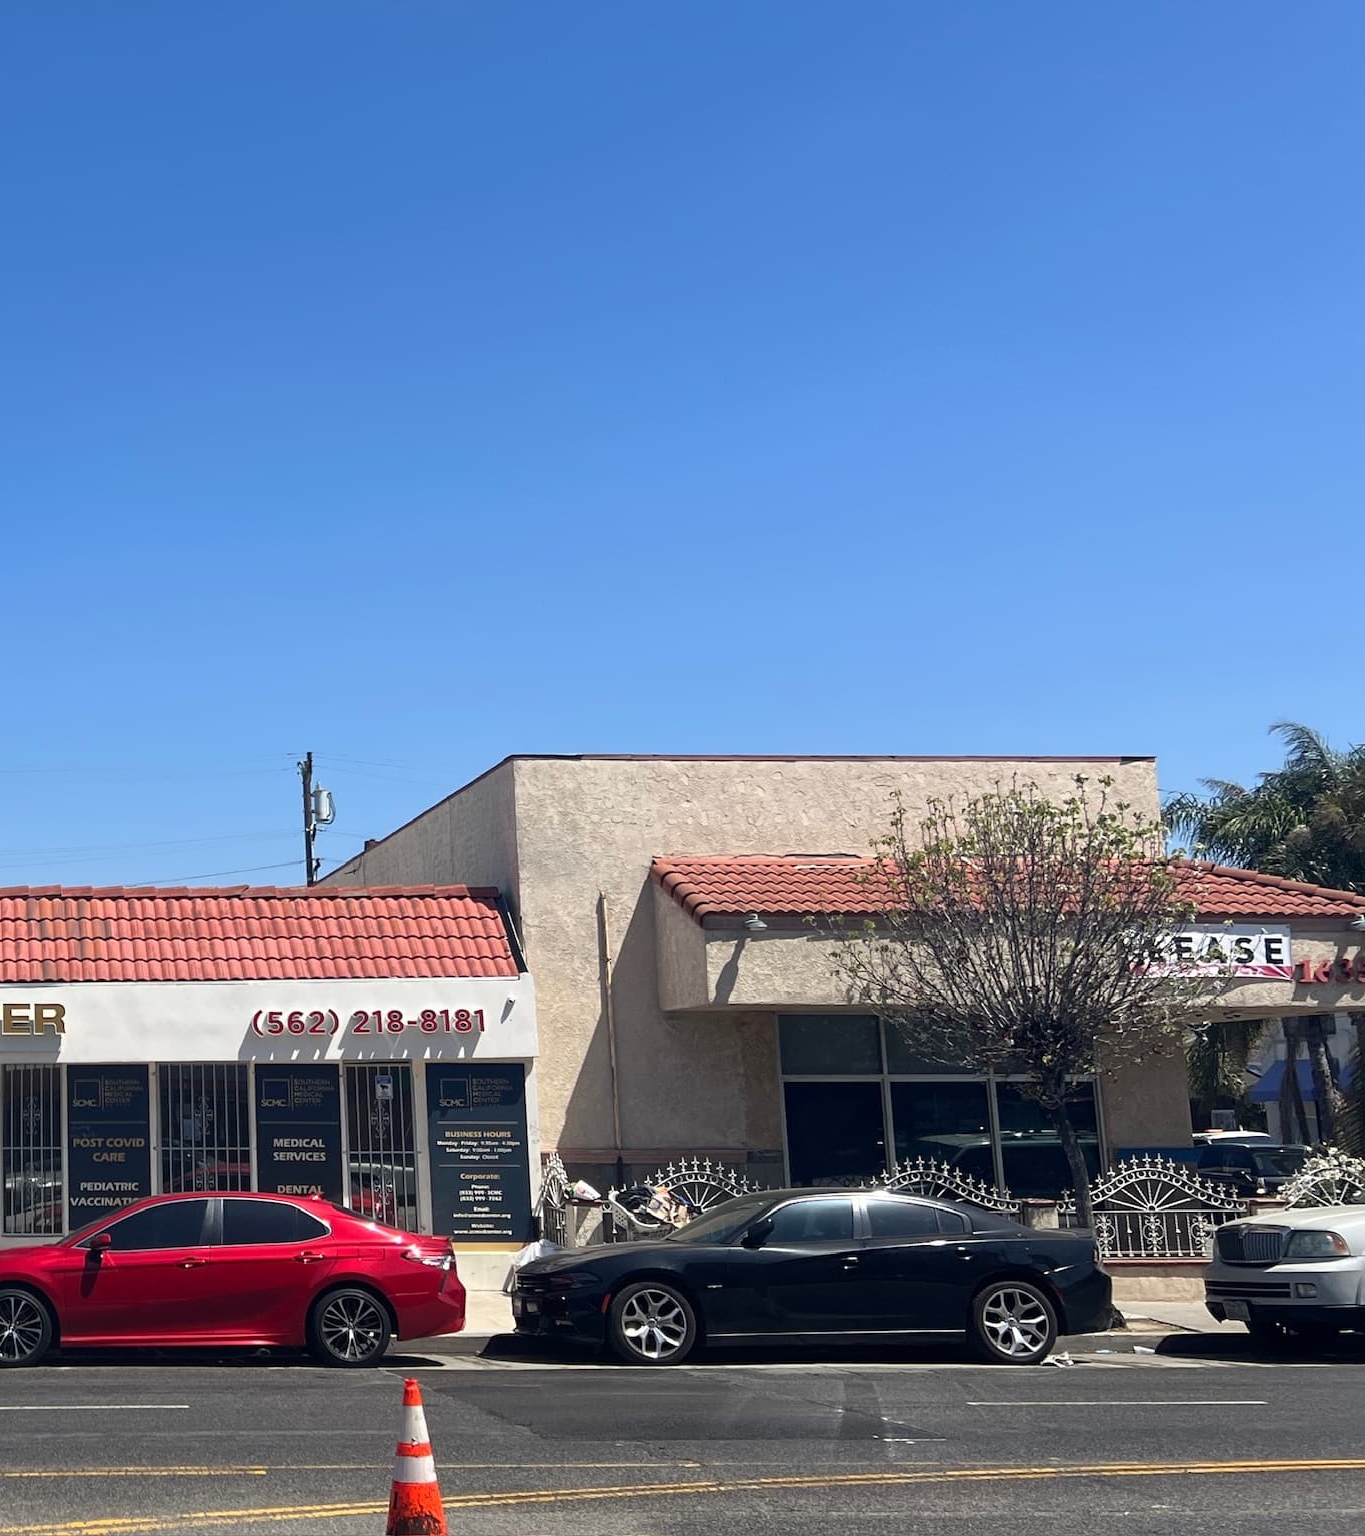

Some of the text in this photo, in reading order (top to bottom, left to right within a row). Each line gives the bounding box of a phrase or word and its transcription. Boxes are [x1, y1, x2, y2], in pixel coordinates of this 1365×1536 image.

[1151, 936, 1284, 965] EASE
[252, 1009, 485, 1036] (562) 218-8181
[73, 1138, 145, 1147] POST COVID
[273, 1139, 325, 1148] MEDICAL
[92, 1152, 126, 1162] CARE
[273, 1151, 326, 1161] SERVICES
[80, 1182, 139, 1191] PEDIATRIC
[277, 1184, 325, 1194] DENTAL
[70, 1197, 140, 1207] VACCINATI
